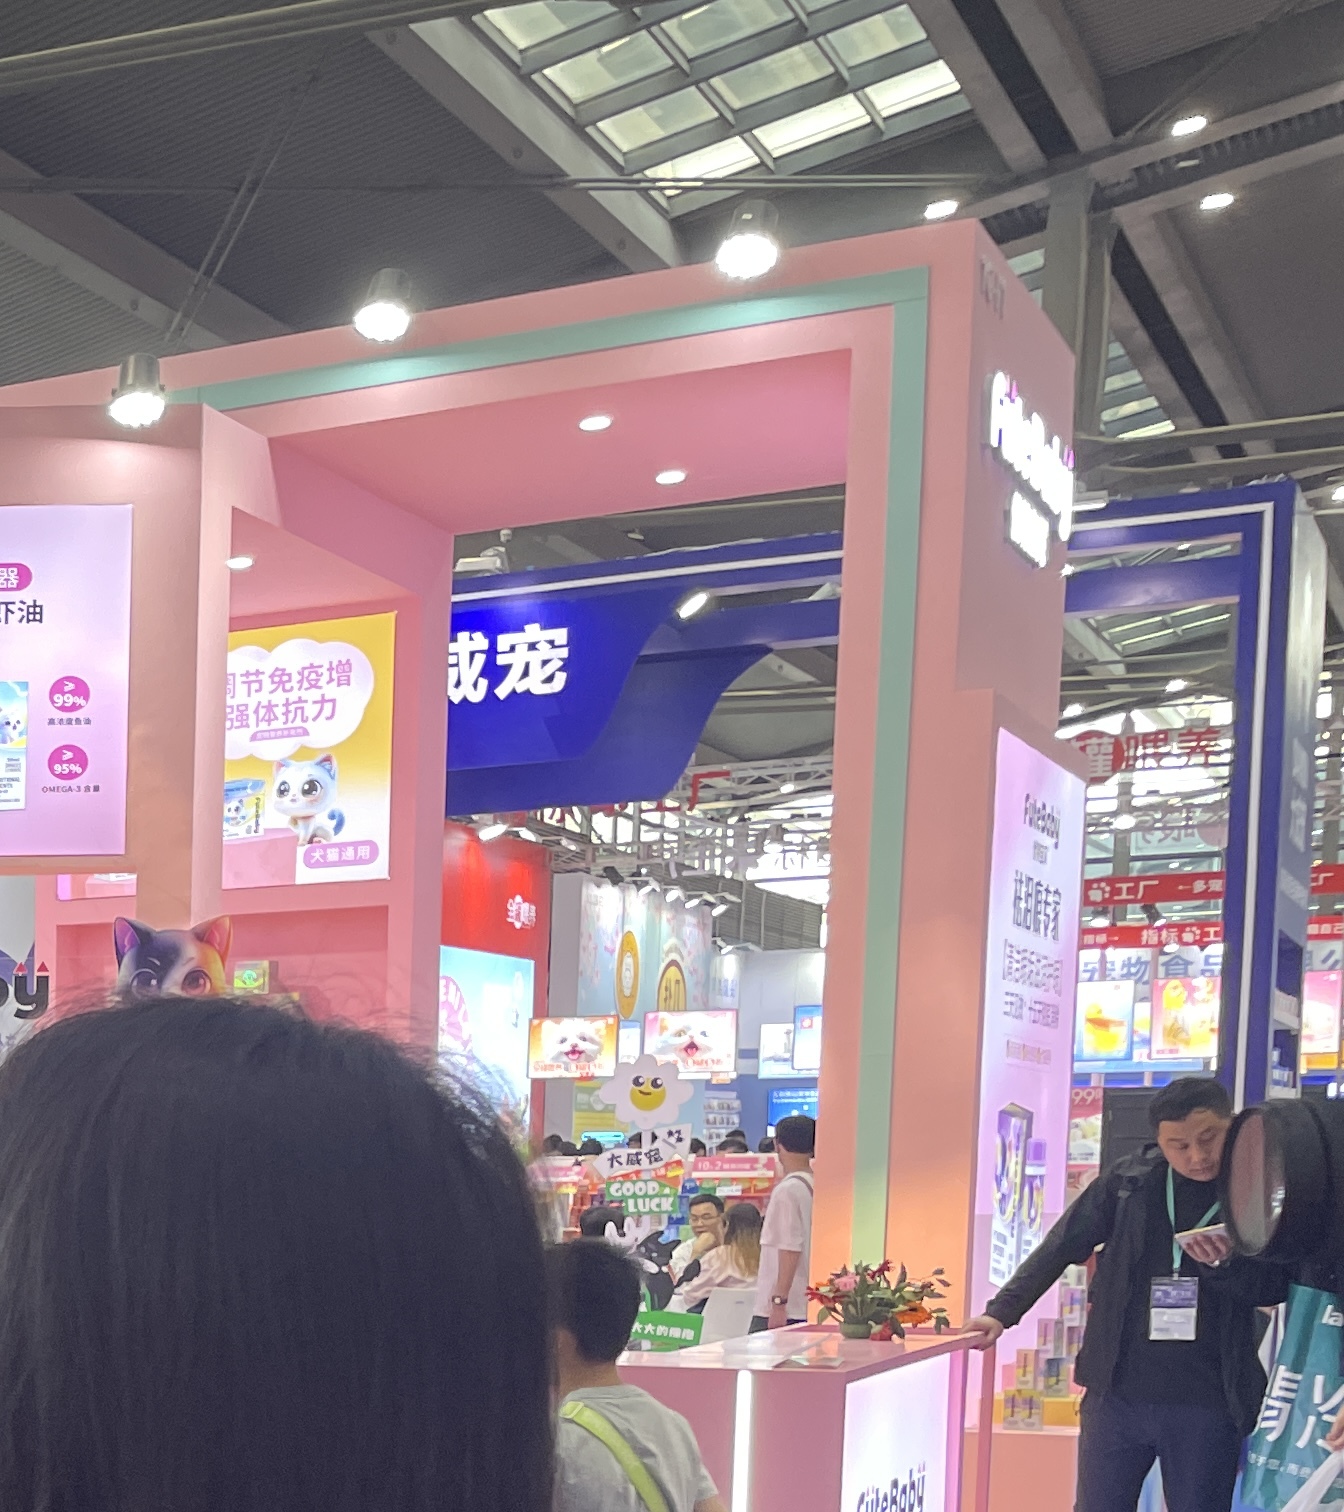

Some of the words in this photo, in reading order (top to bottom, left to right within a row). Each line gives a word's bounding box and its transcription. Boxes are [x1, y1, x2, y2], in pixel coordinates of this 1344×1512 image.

[53, 693, 87, 708] 99%
[53, 763, 83, 775] 95%
[310, 846, 370, 864] 犬猫通用
[1113, 879, 1160, 900] 工厂
[611, 1180, 658, 1196] GOOD
[627, 1197, 674, 1213] LUCK
